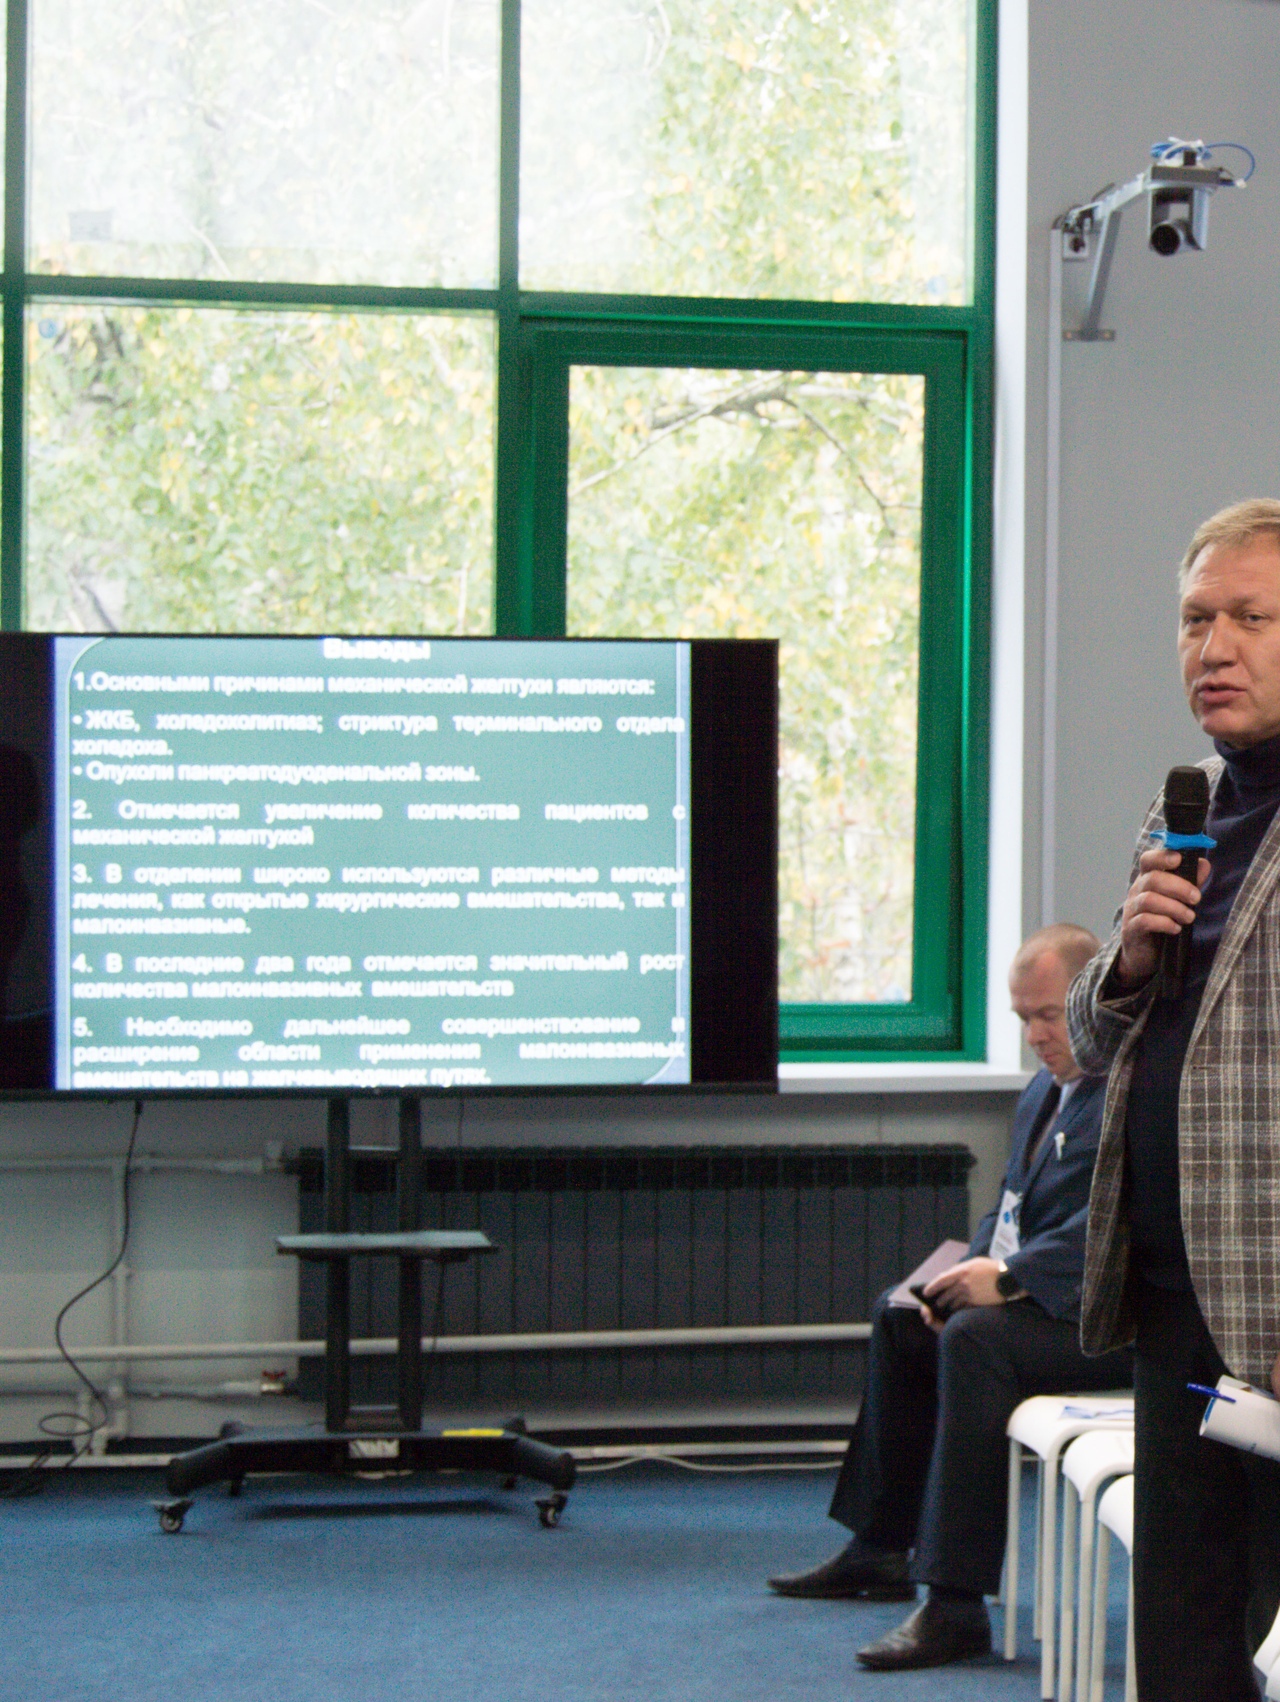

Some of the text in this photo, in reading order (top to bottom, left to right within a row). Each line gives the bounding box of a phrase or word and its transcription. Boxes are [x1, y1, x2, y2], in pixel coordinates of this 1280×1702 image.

[323, 638, 430, 662] Выводы
[74, 671, 655, 698] 1.Основными причинами механической желтухи являются:
[87, 710, 685, 735] ЖКБ, холедохолитиаз; структура терминального отдела
[72, 740, 173, 757] холедоха.
[86, 762, 480, 785] Опухоли панкреатодуоденальной зоны.
[72, 800, 685, 823] 2. Отмечается увеличение количества пациентов с
[73, 826, 314, 849] механической желтухой
[72, 864, 685, 887] 3. В отделении широко используются различные методы
[72, 892, 685, 912] лечения, как открытые хирургические вмешательства, так и
[73, 917, 251, 934] малоинвазивные.
[72, 952, 684, 975] 4. В последние два года отмечается значительный рост
[73, 980, 514, 998] количества малоинвазивных вмешательств
[73, 1015, 685, 1039] 5. Необходимо дальнейшее совершенствование и
[73, 1041, 685, 1065] расширение области применения малоинвазивных
[73, 1070, 218, 1088] вмешательств
[223, 1070, 248, 1086] на
